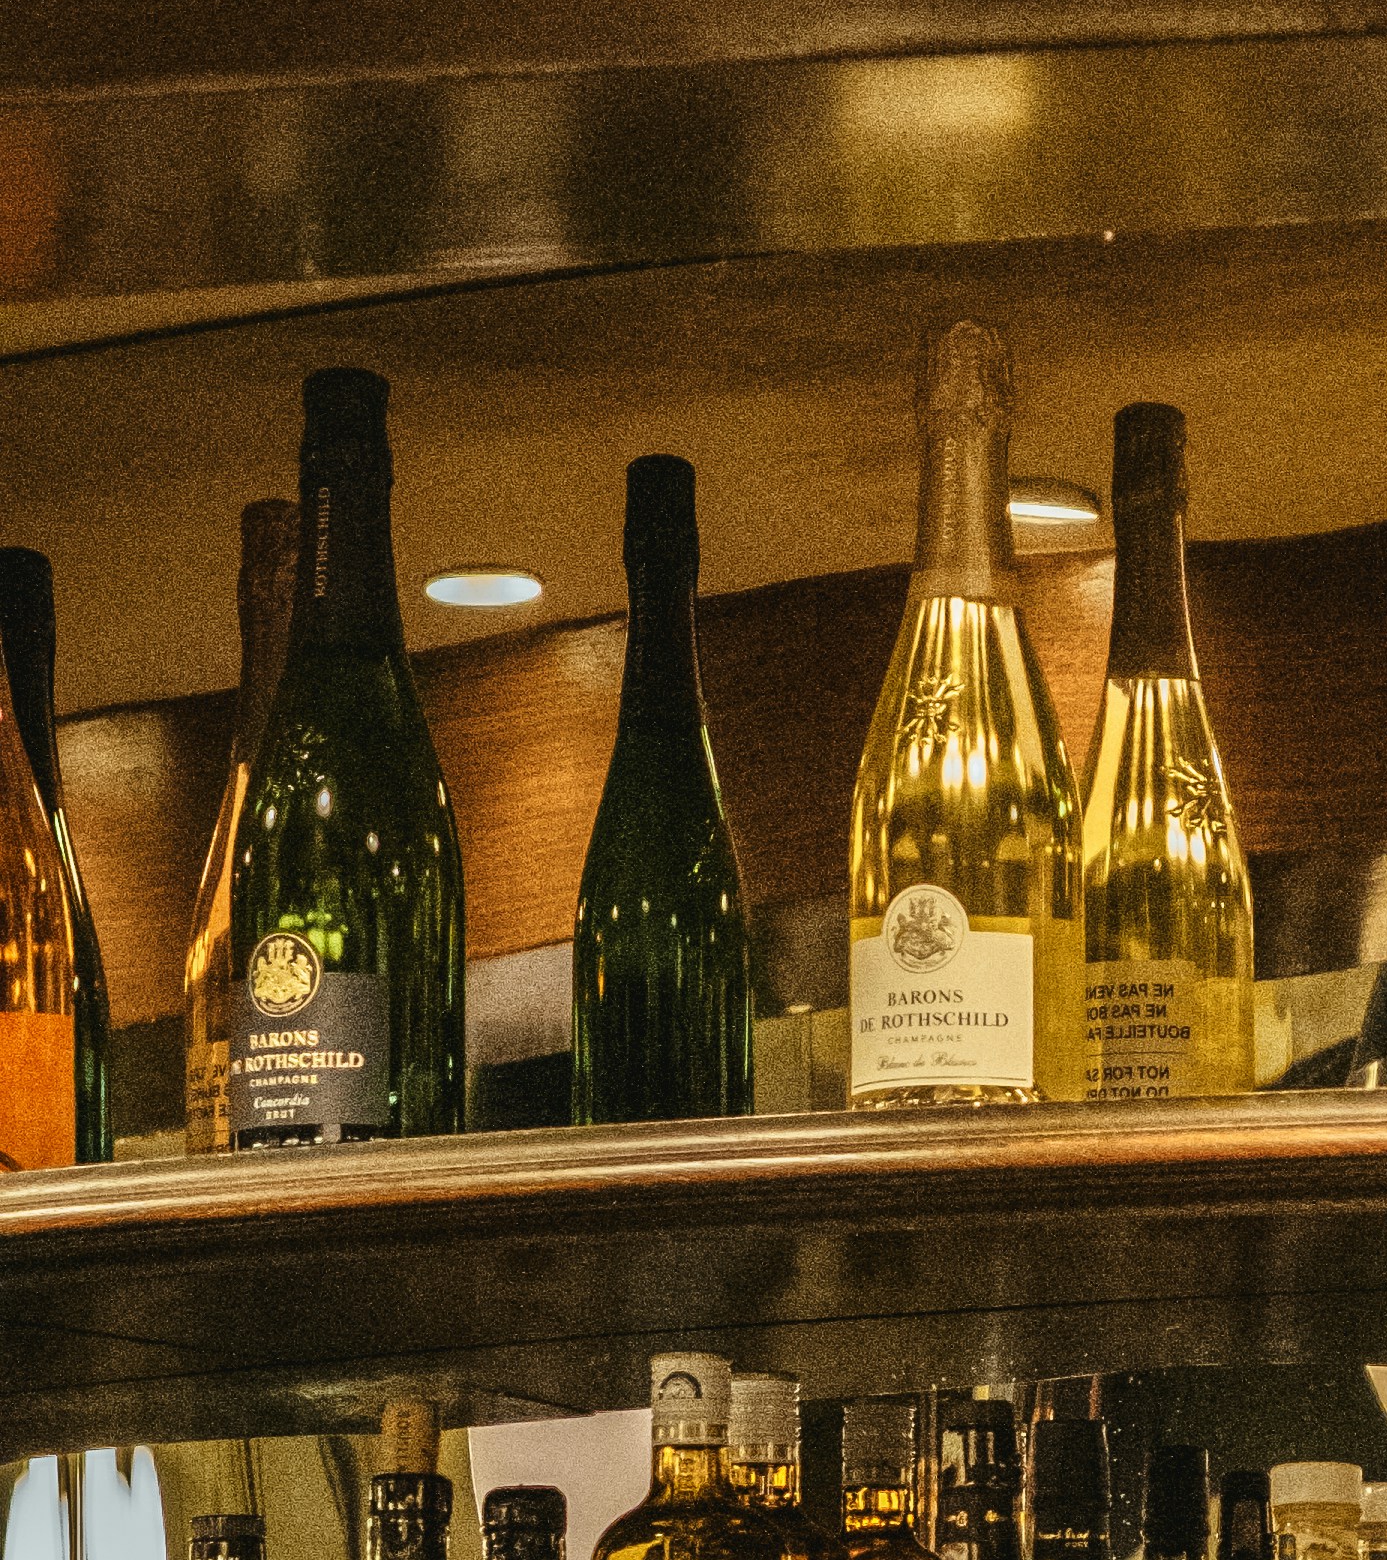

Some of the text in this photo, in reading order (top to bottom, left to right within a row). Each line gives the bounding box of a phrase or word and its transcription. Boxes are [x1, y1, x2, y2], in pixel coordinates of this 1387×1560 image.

[888, 989, 963, 1006] BARONS
[860, 1012, 1009, 1033] DE ROTHSCHILD
[250, 1030, 319, 1049] BARONS
[887, 1034, 963, 1045] CHAMPAGNE
[245, 1052, 364, 1073] ROTHSCHILD
[250, 1075, 318, 1087] CHAMPAGNE
[254, 1093, 310, 1108] Concordia
[265, 1109, 295, 1120] BRUT
